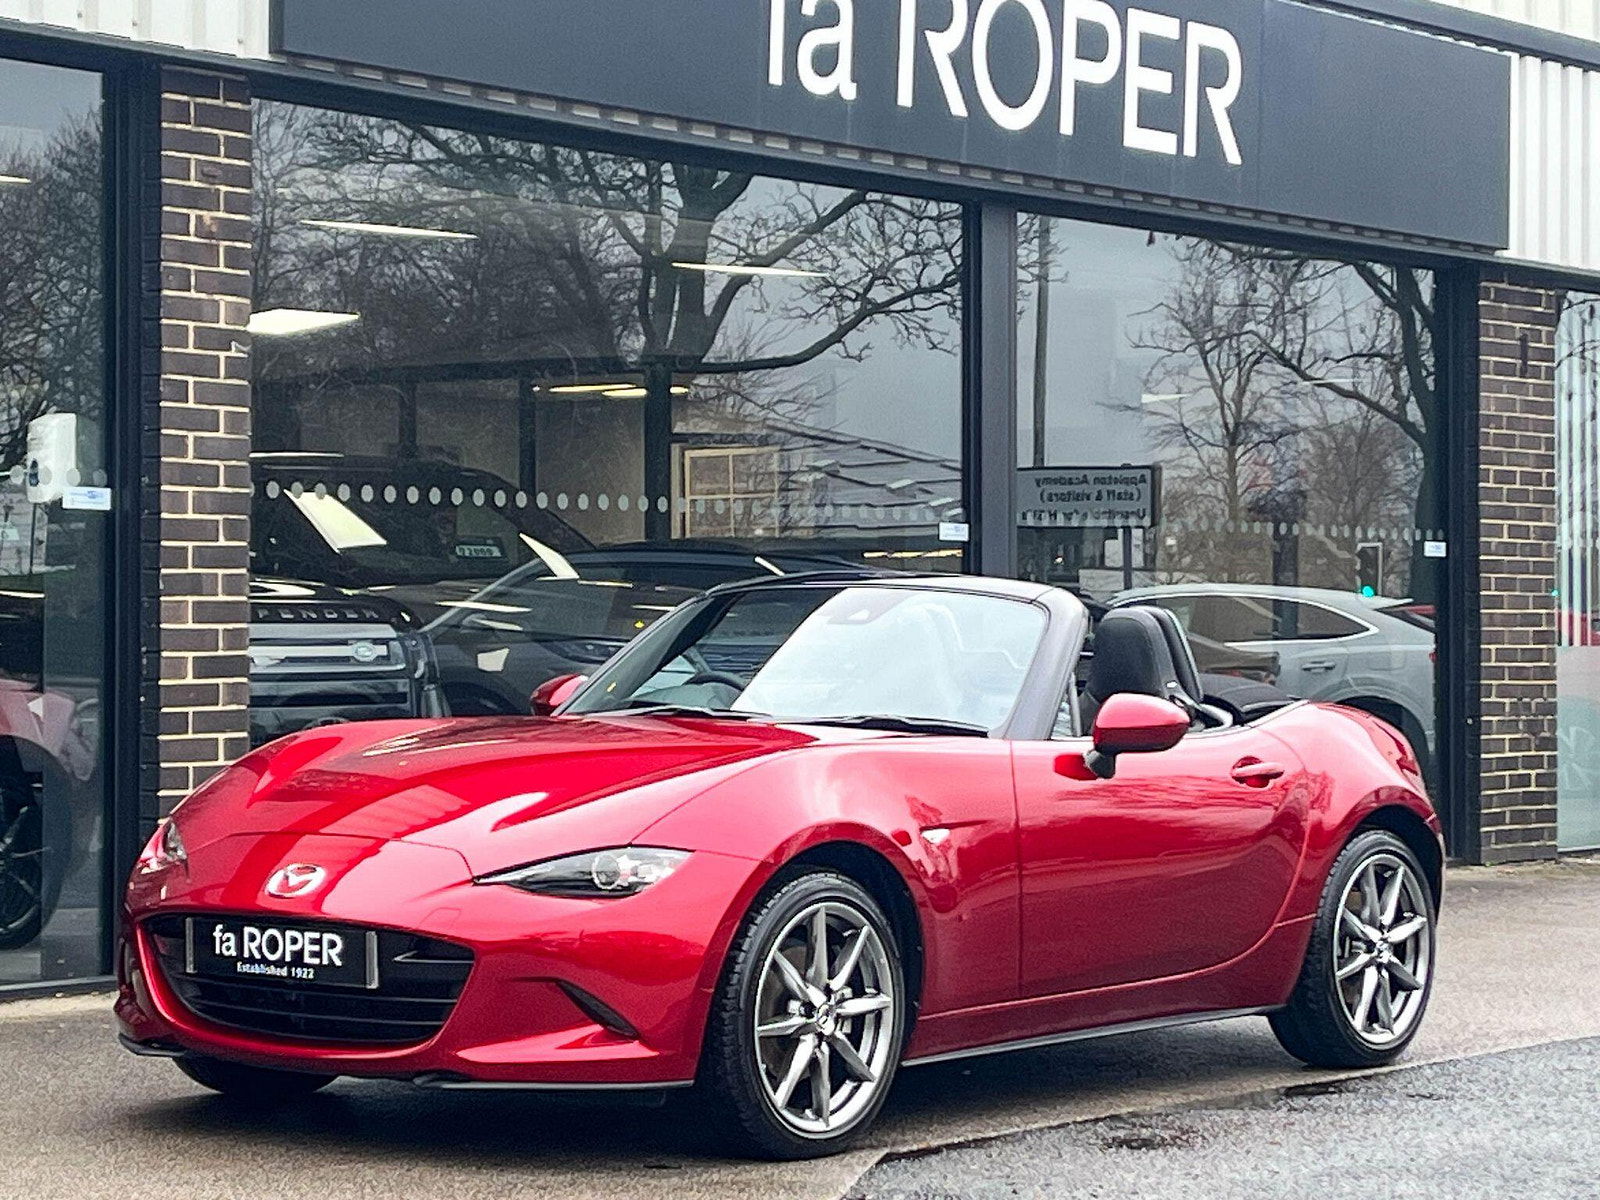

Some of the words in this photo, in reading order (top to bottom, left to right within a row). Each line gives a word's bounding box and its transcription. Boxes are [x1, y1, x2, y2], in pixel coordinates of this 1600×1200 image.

[897, 0, 1242, 166] ROPER
[213, 924, 237, 956] fa
[243, 926, 342, 966] ROPER
[236, 961, 288, 976] Established
[291, 967, 315, 979] 1922
